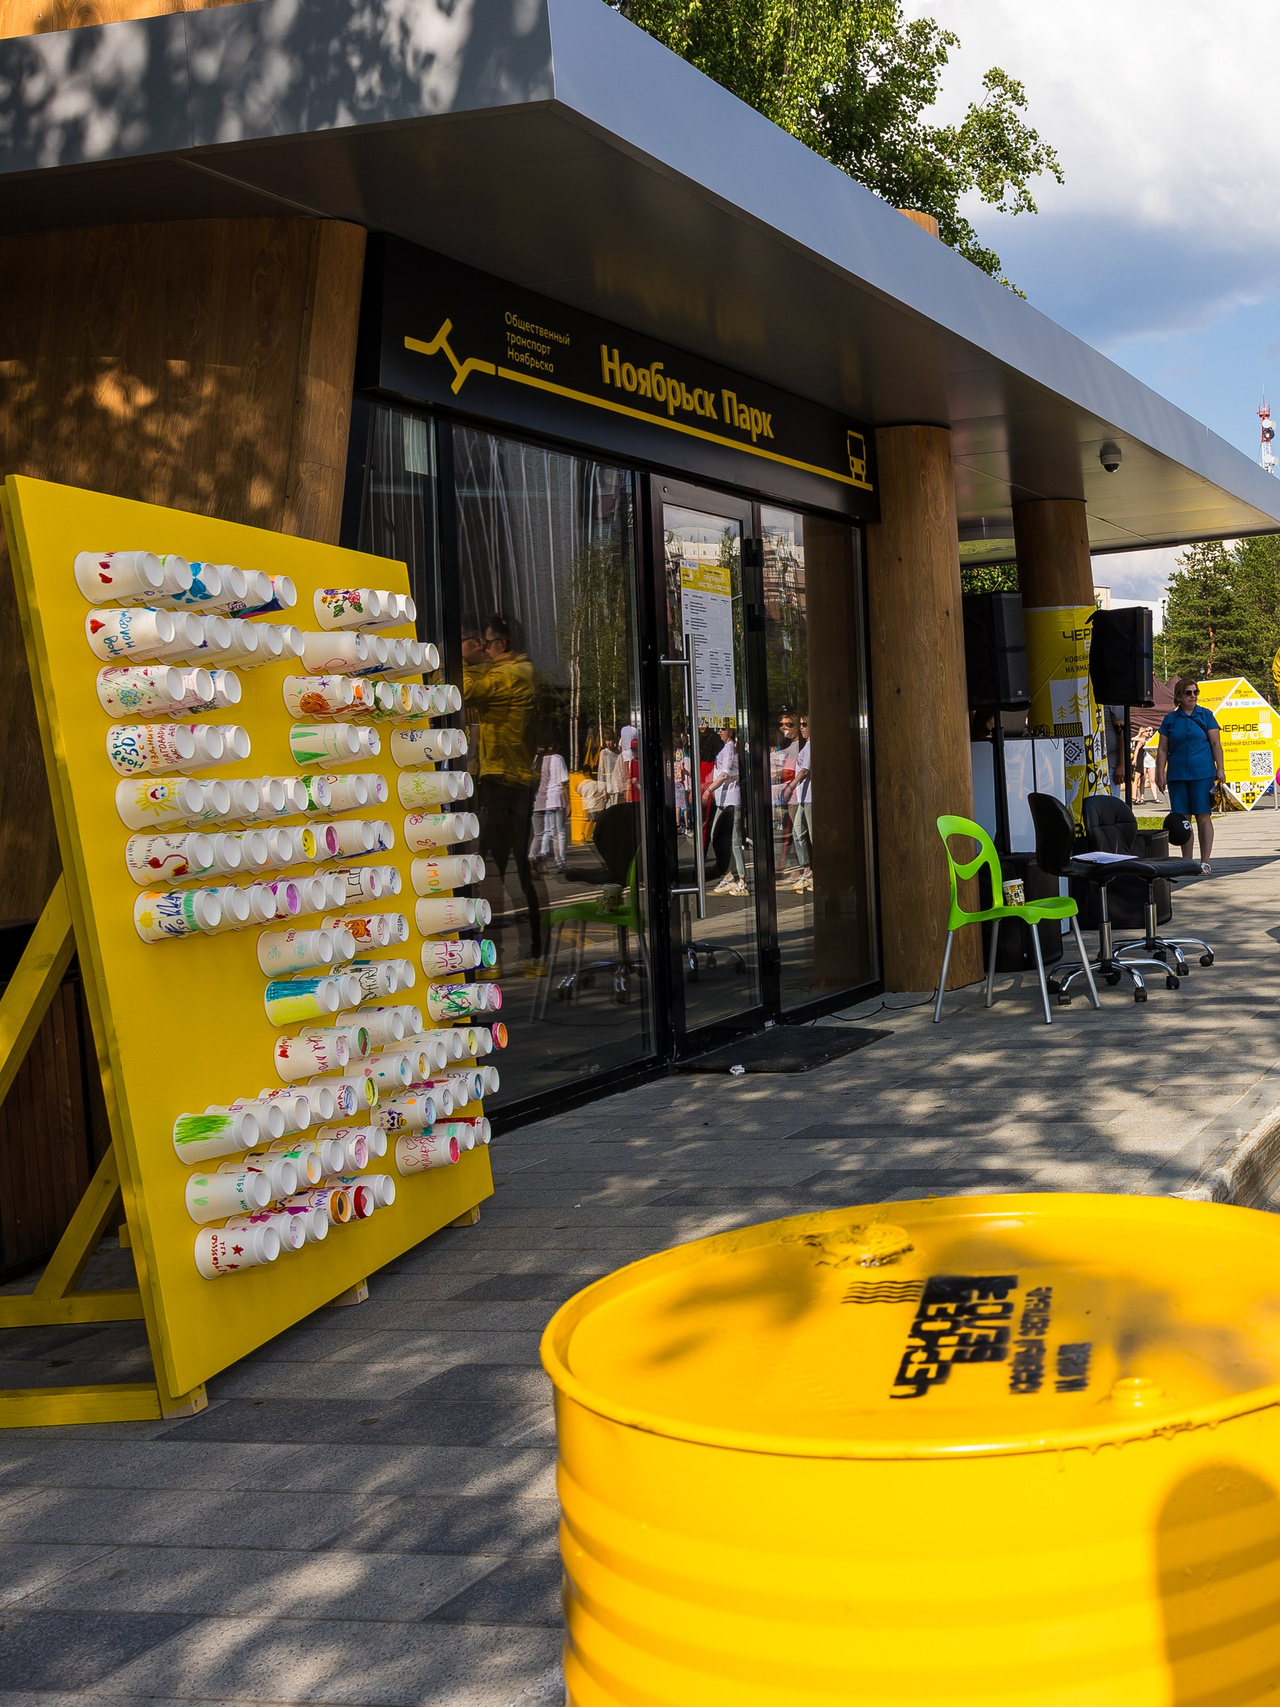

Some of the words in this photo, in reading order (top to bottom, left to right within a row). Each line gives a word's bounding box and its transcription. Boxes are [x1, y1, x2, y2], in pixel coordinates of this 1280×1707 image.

[505, 311, 570, 346] Общественный
[506, 331, 551, 356] транспорт
[507, 346, 554, 373] Ноябрьска
[600, 344, 718, 419] Ноябрьск
[721, 388, 775, 442] Парк
[1062, 628, 1092, 641] ЧЕР
[120, 737, 139, 757] 50
[235, 1174, 246, 1193] ТЕБЯ
[889, 1301, 966, 1399] ЧЕРНОЕ
